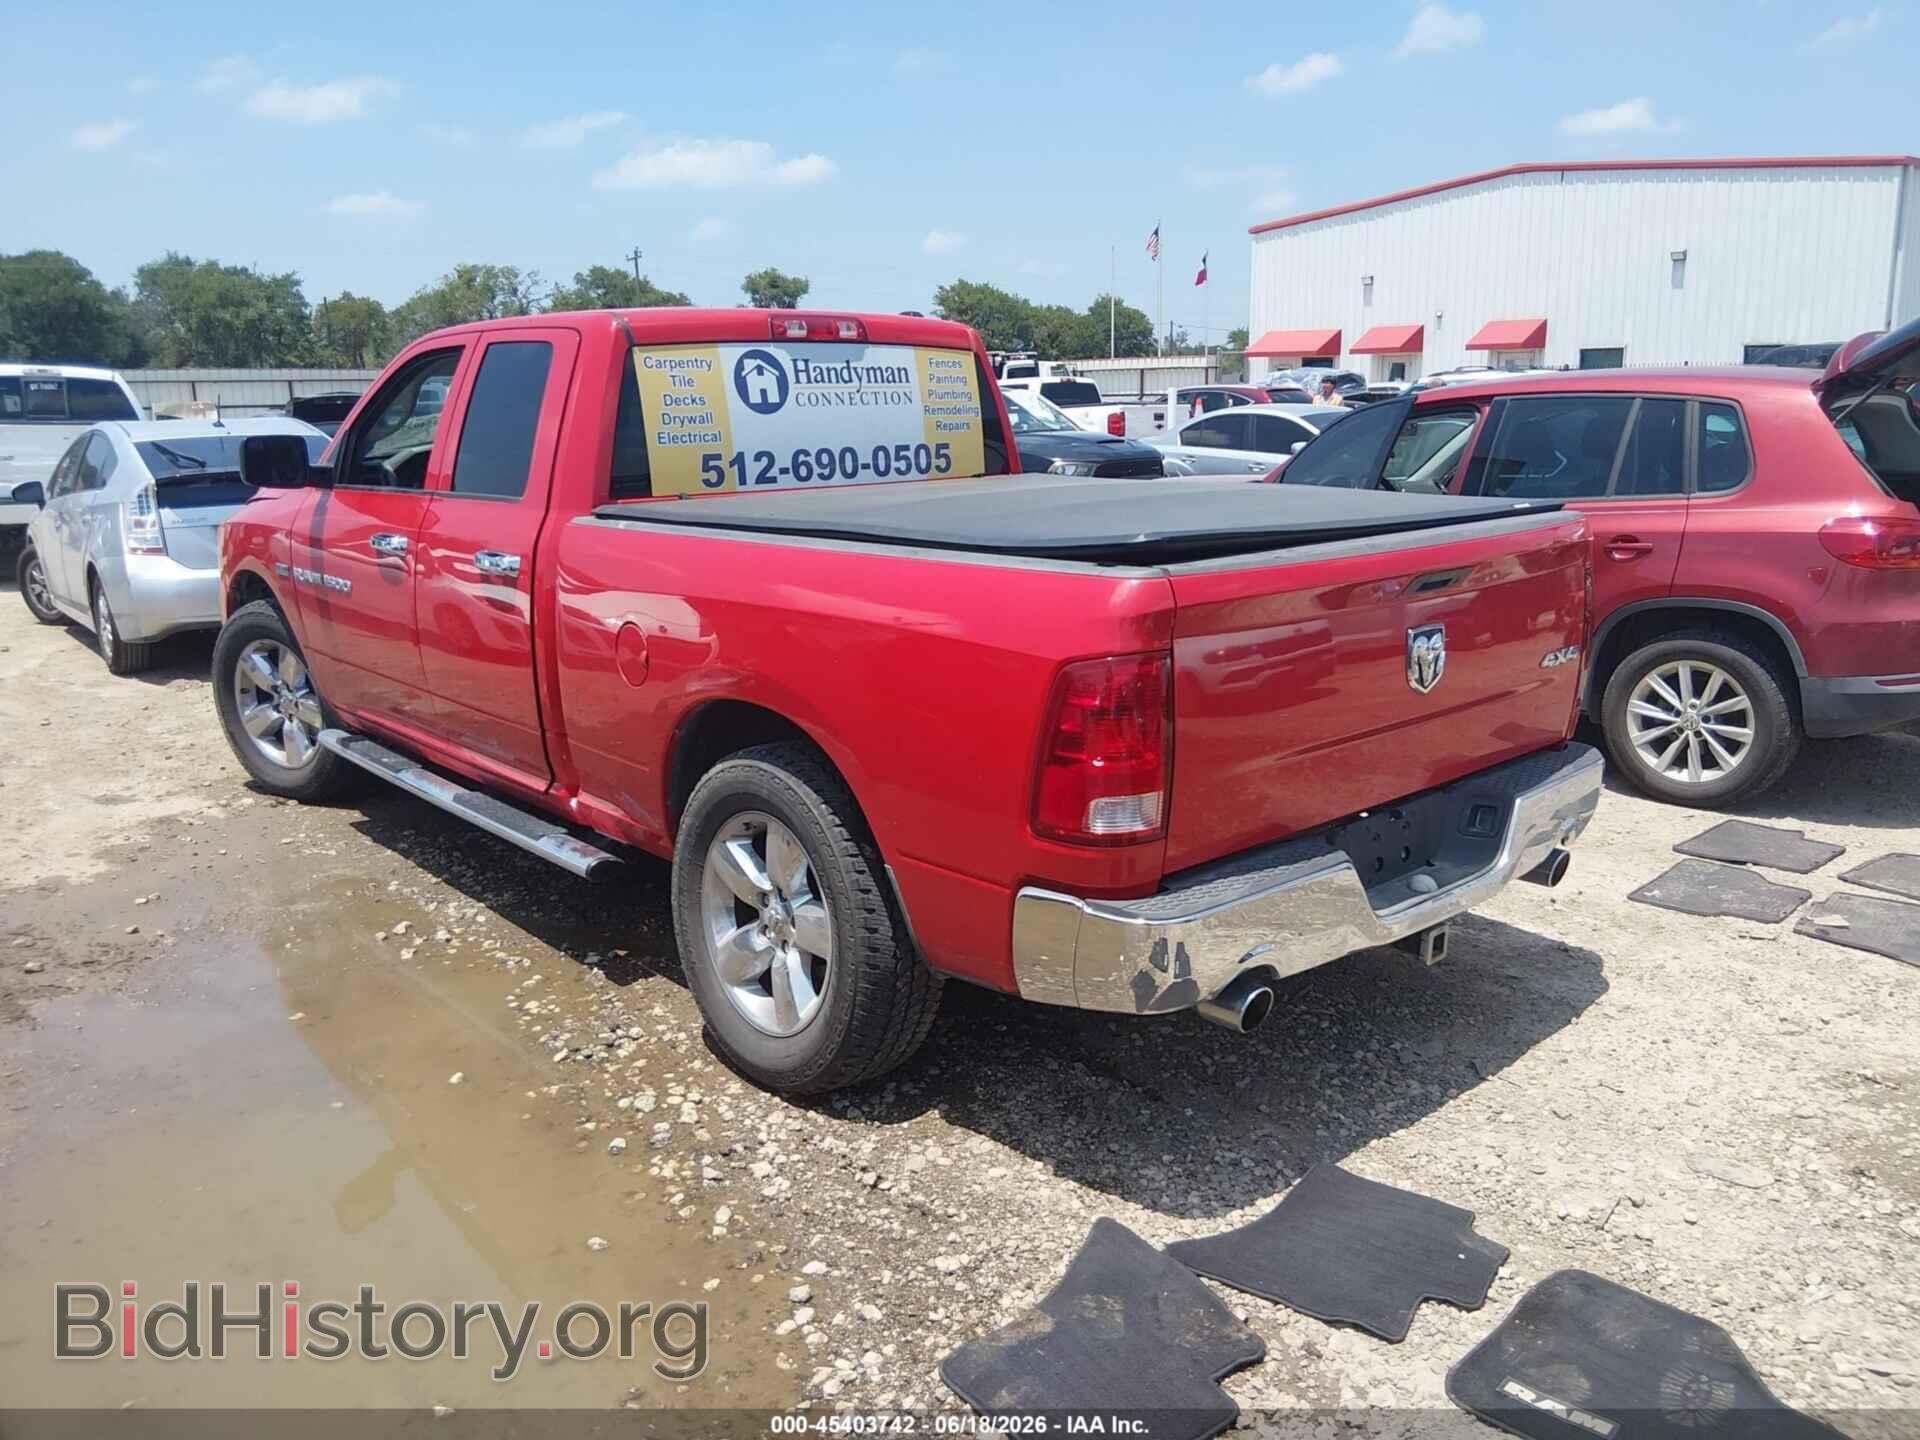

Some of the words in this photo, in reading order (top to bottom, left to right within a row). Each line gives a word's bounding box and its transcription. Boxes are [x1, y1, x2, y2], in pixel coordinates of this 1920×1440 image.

[643, 356, 712, 372] Carpentry
[928, 357, 963, 369] Fences
[669, 375, 695, 388] Tile
[791, 358, 910, 393] Handyman
[928, 373, 968, 386] Painting
[663, 393, 706, 407] Decks
[795, 390, 914, 408] CONNECTION
[927, 389, 973, 402] Plumbing
[923, 405, 980, 417] Remodeling
[661, 412, 714, 429] Drywall
[935, 420, 971, 432] Repairs
[657, 430, 722, 445] Electrical
[701, 443, 952, 489] 512-690-0505
[1502, 1380, 1615, 1436] RAM
